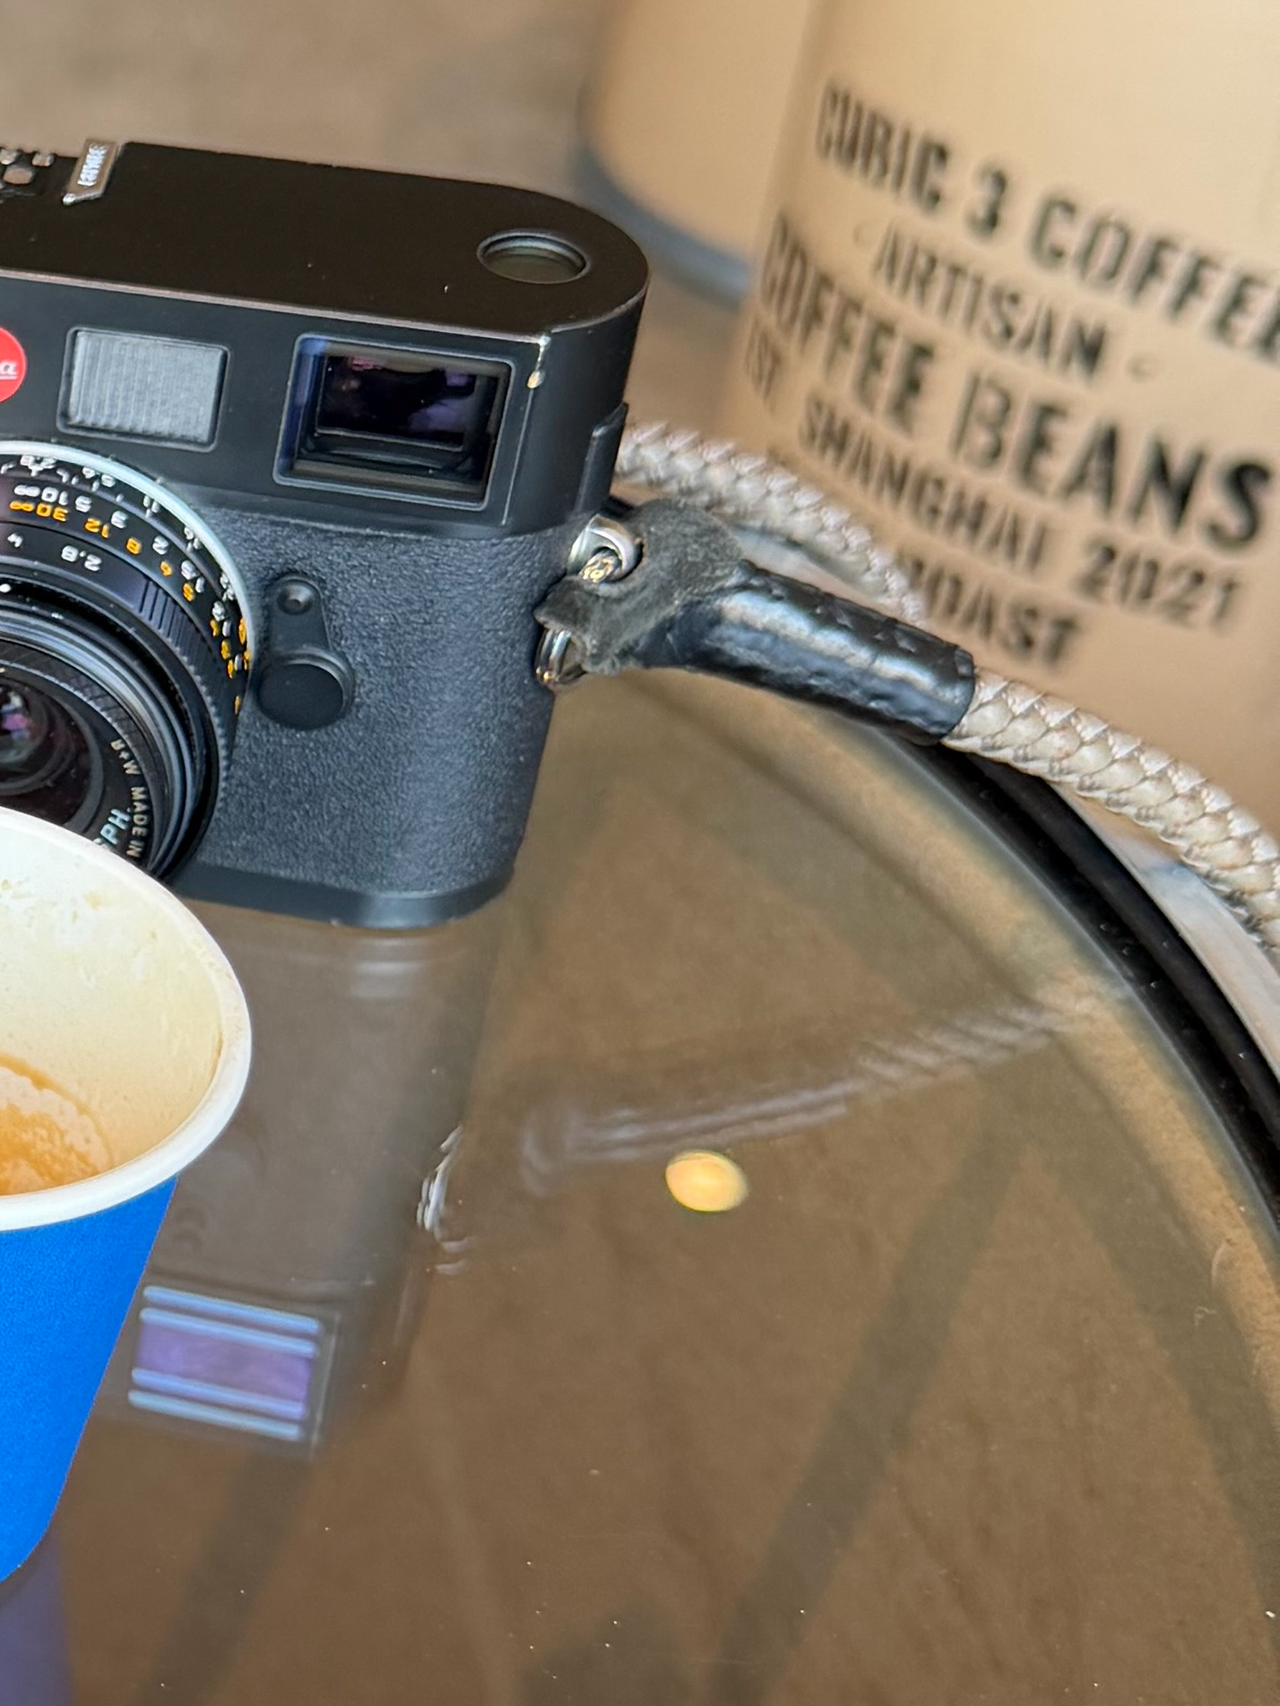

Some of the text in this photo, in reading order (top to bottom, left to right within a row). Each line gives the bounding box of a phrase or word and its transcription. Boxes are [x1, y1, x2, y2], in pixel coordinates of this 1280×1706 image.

[968, 165, 1009, 242] 3
[872, 219, 1110, 382] ARTISAN
[950, 371, 1270, 550] BEANS
[35, 502, 69, 522] 30
[798, 398, 1049, 571] SHANGHAI
[1078, 539, 1246, 628] 2021
[131, 785, 150, 837] MADE
[126, 844, 144, 859] IN
